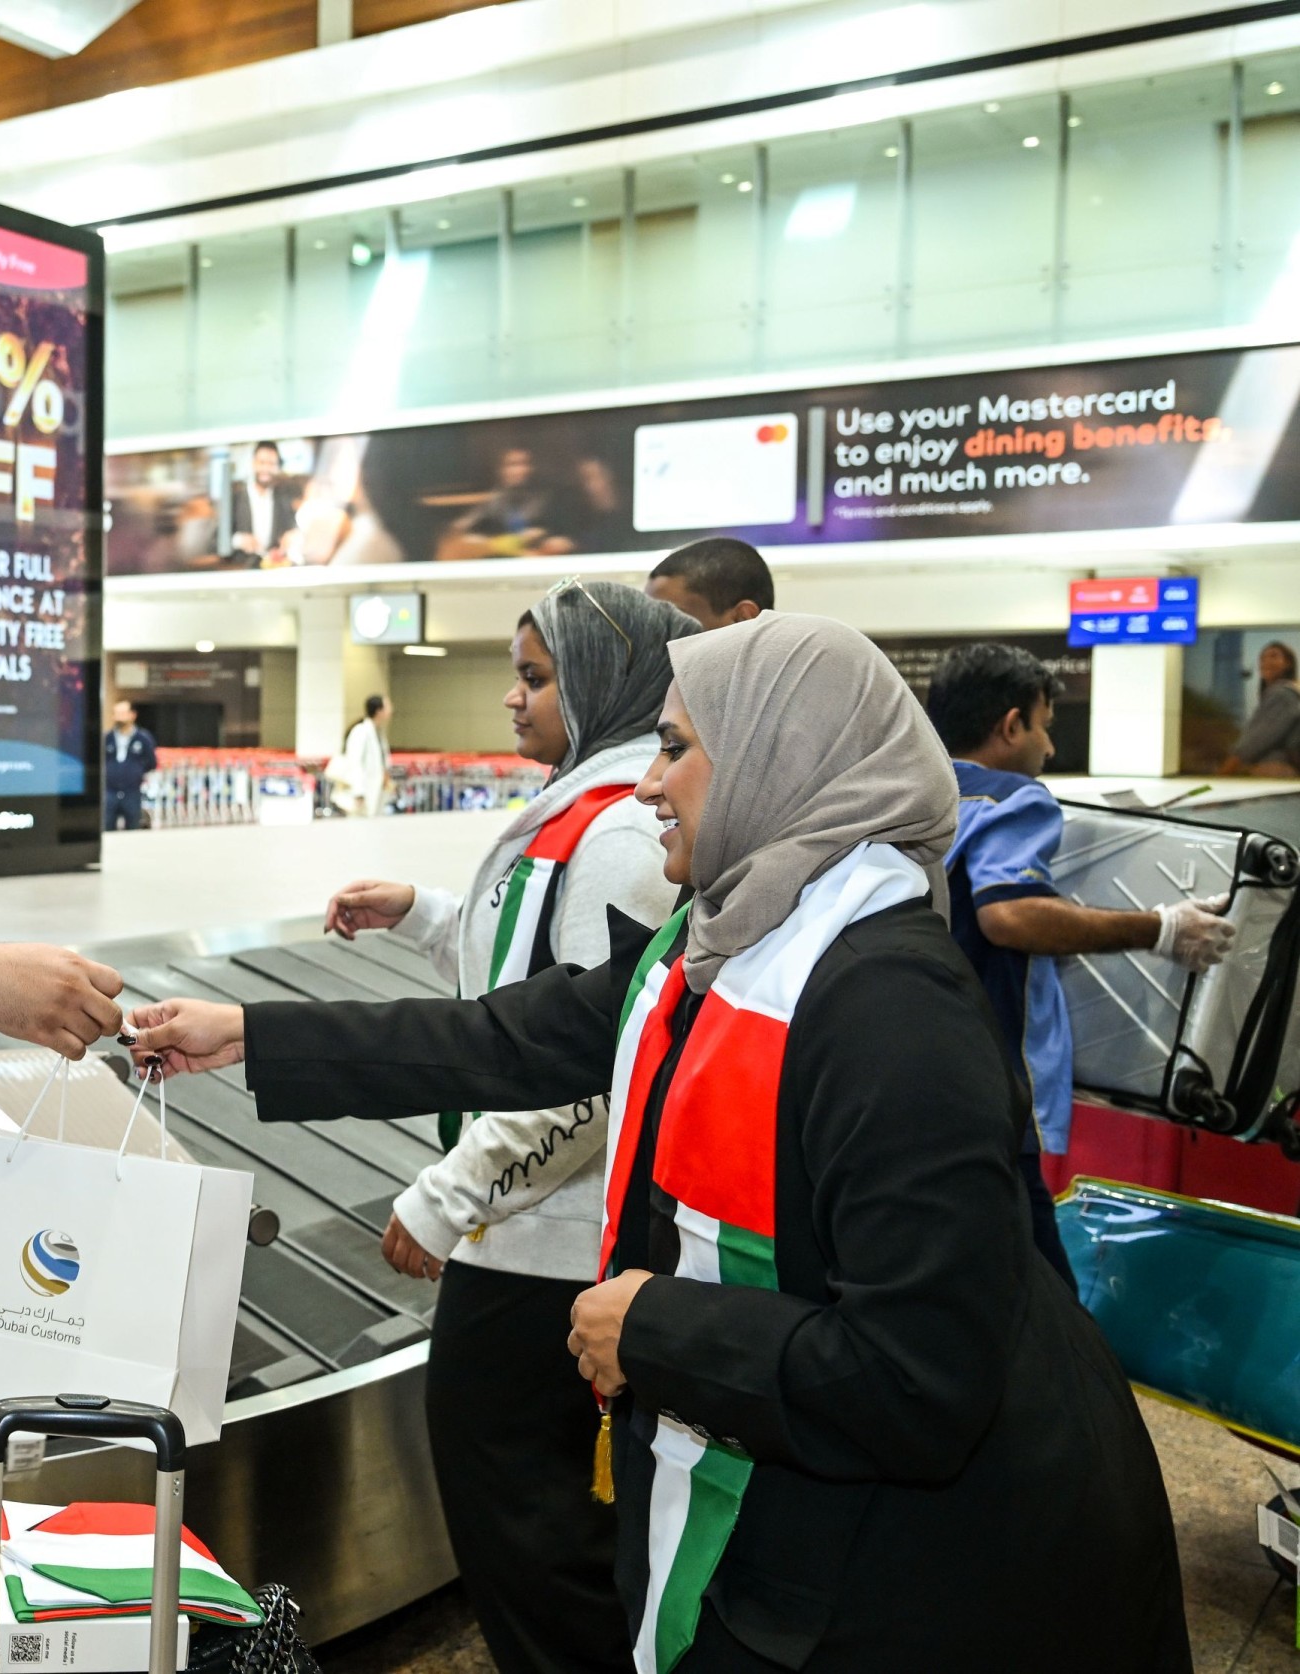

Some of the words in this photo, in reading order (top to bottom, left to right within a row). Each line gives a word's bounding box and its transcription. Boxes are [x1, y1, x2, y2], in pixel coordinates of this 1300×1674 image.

[836, 406, 894, 437] Use
[898, 403, 972, 438] your
[978, 378, 1176, 426] Mastercard
[834, 441, 870, 468] to
[874, 433, 959, 469] enjoy
[963, 424, 1066, 459] dining
[833, 466, 894, 499] and
[899, 461, 988, 495] much
[994, 461, 1091, 489] more.
[13, 550, 54, 583] FULL
[38, 590, 66, 617] AT
[25, 622, 66, 651] FREE
[33, 1306, 85, 1331] جمارك
[31, 1324, 82, 1346] Customs
